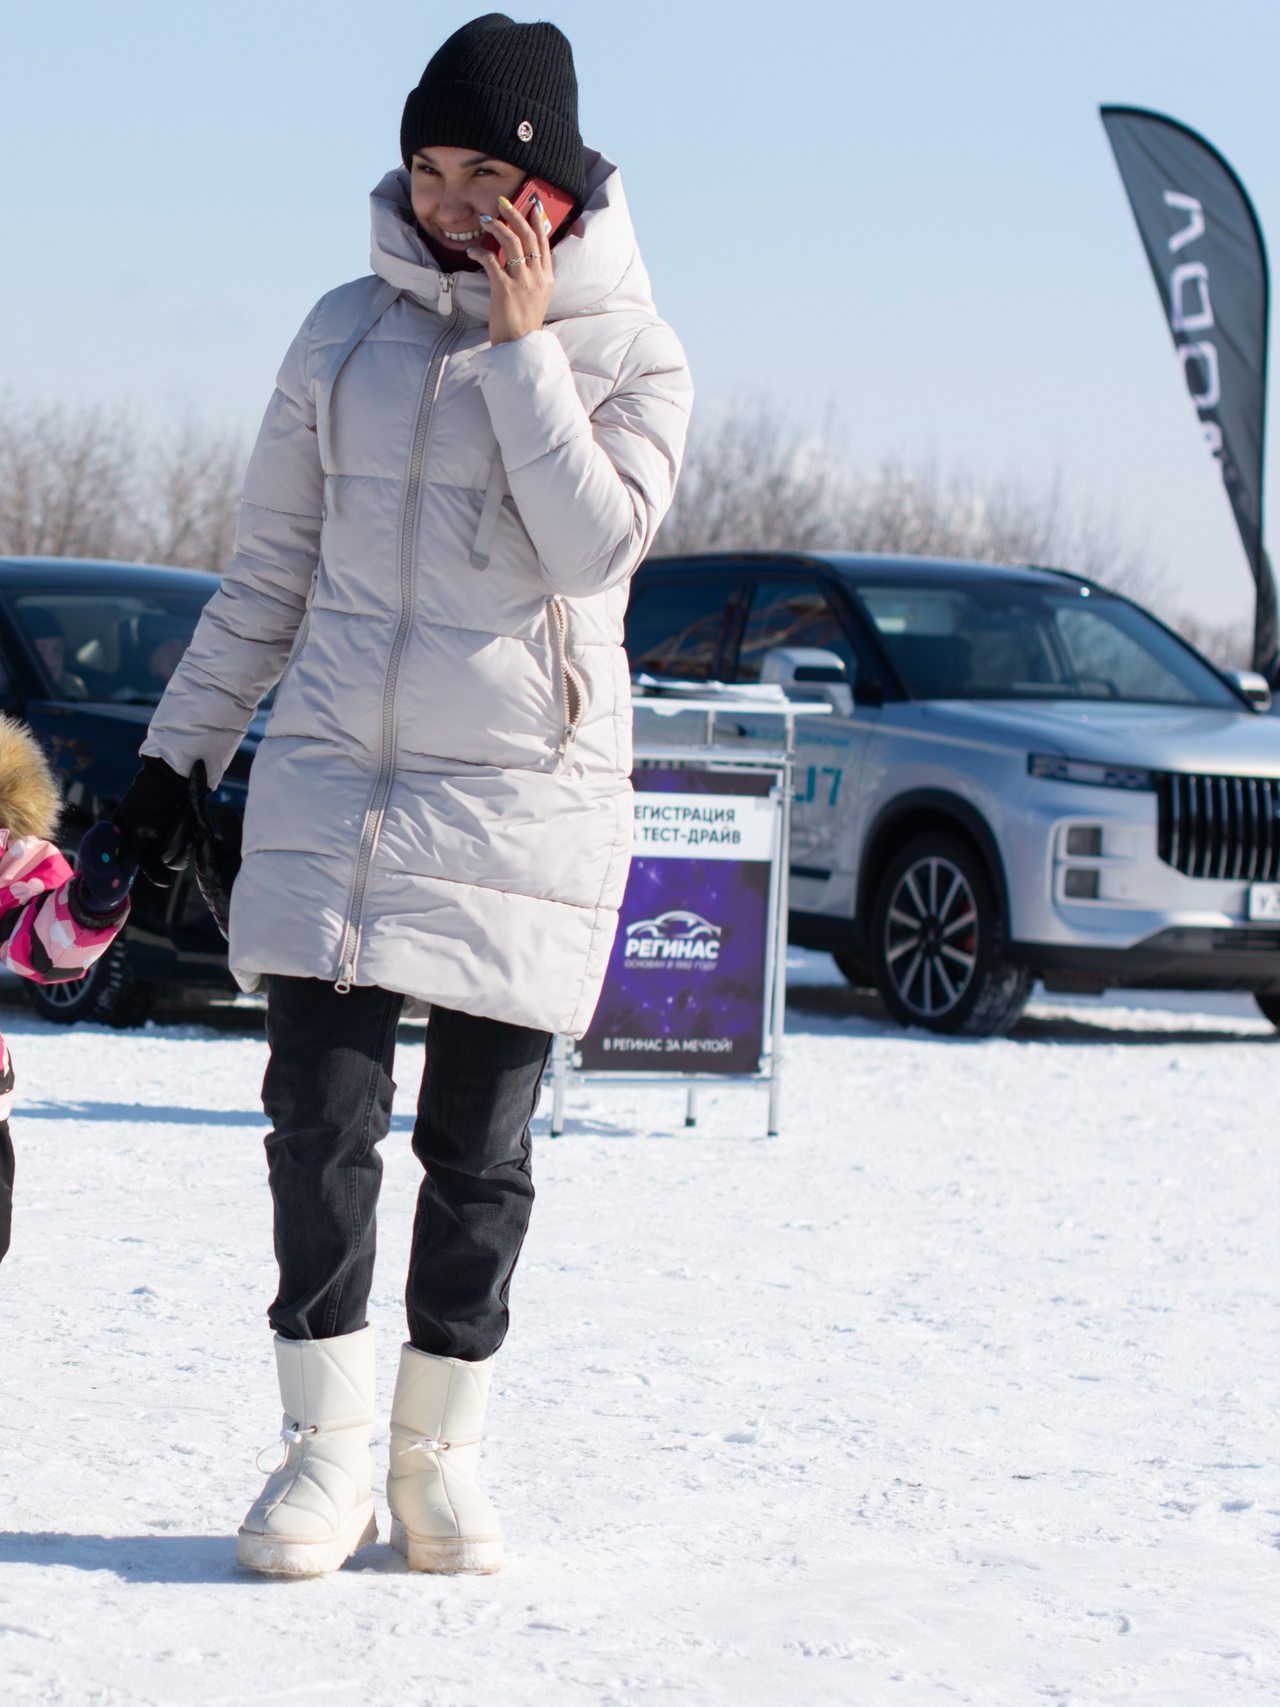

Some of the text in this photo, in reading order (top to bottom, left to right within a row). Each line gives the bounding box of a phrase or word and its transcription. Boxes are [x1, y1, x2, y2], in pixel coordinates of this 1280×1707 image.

[633, 805, 736, 824] ЕГИСТРАЦИЯ
[642, 825, 742, 845] ТЕСТ-ДРАЙВ
[624, 938, 721, 960] РЕГИНАС
[603, 1036, 733, 1054] В РЕГИНАС ЗА МЕЧТОЙ!
